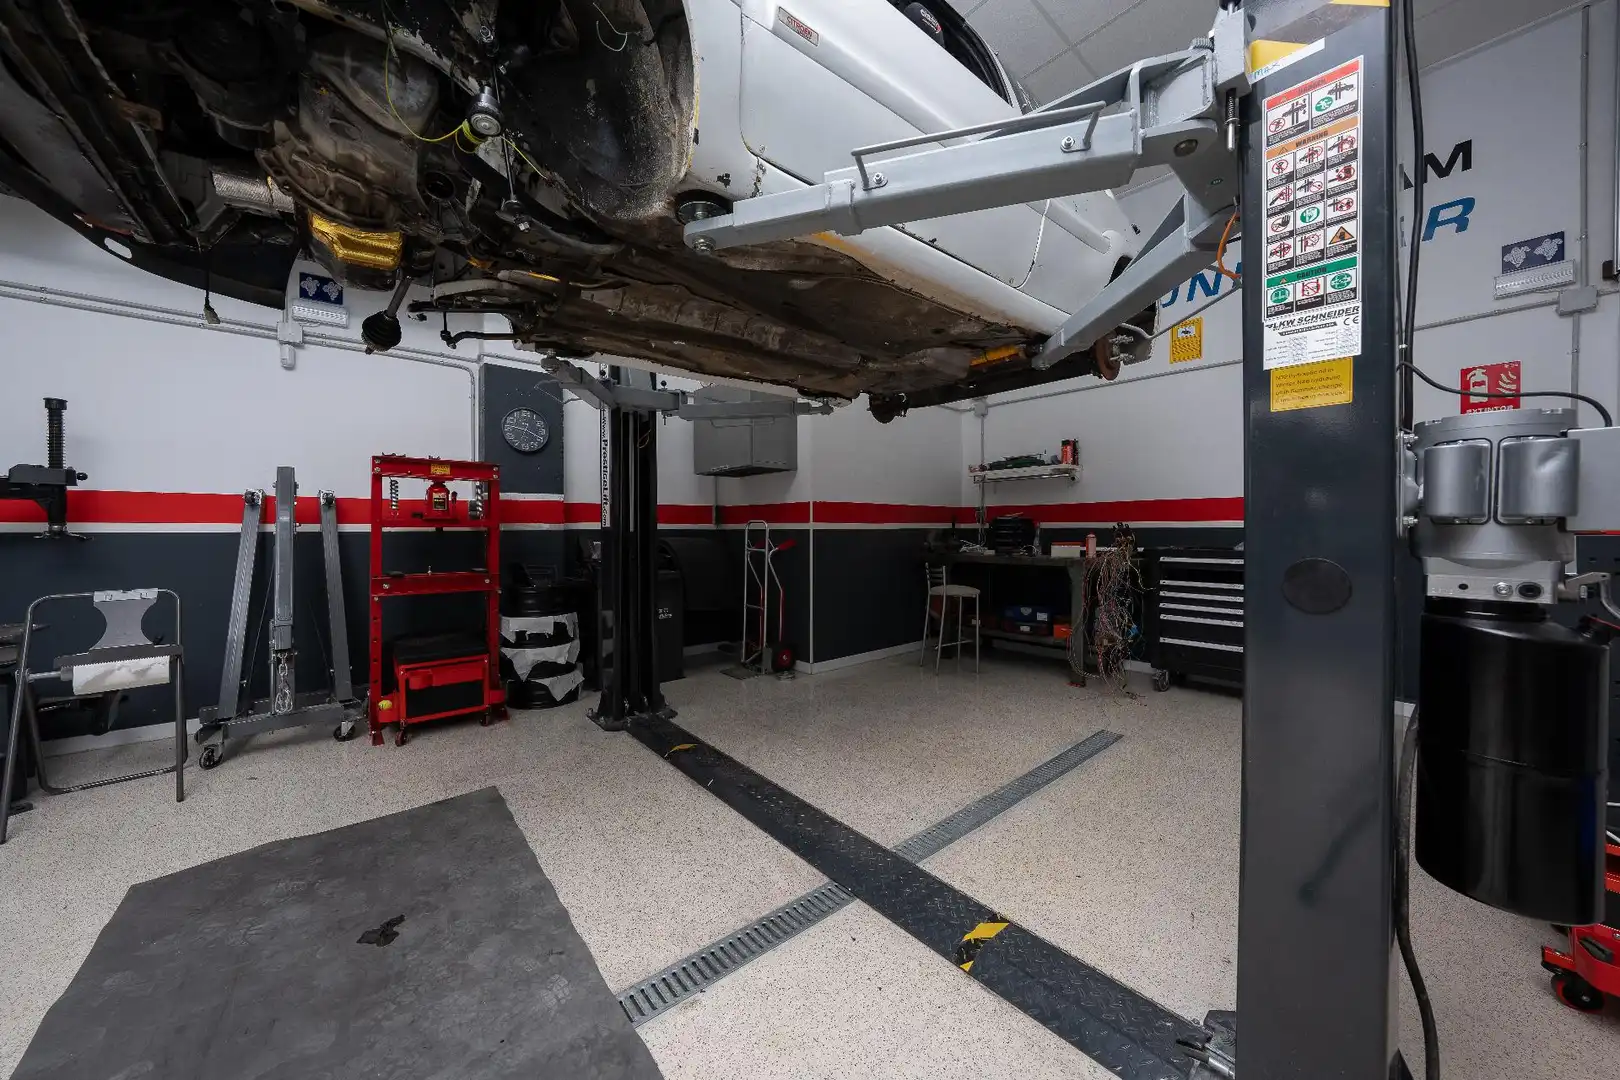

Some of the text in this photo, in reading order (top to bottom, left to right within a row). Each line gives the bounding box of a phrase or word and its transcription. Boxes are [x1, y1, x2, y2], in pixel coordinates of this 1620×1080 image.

[1296, 130, 1328, 147] WARNING
[1273, 319, 1296, 330] LKW
[1297, 306, 1360, 324] SCHNEIDER
